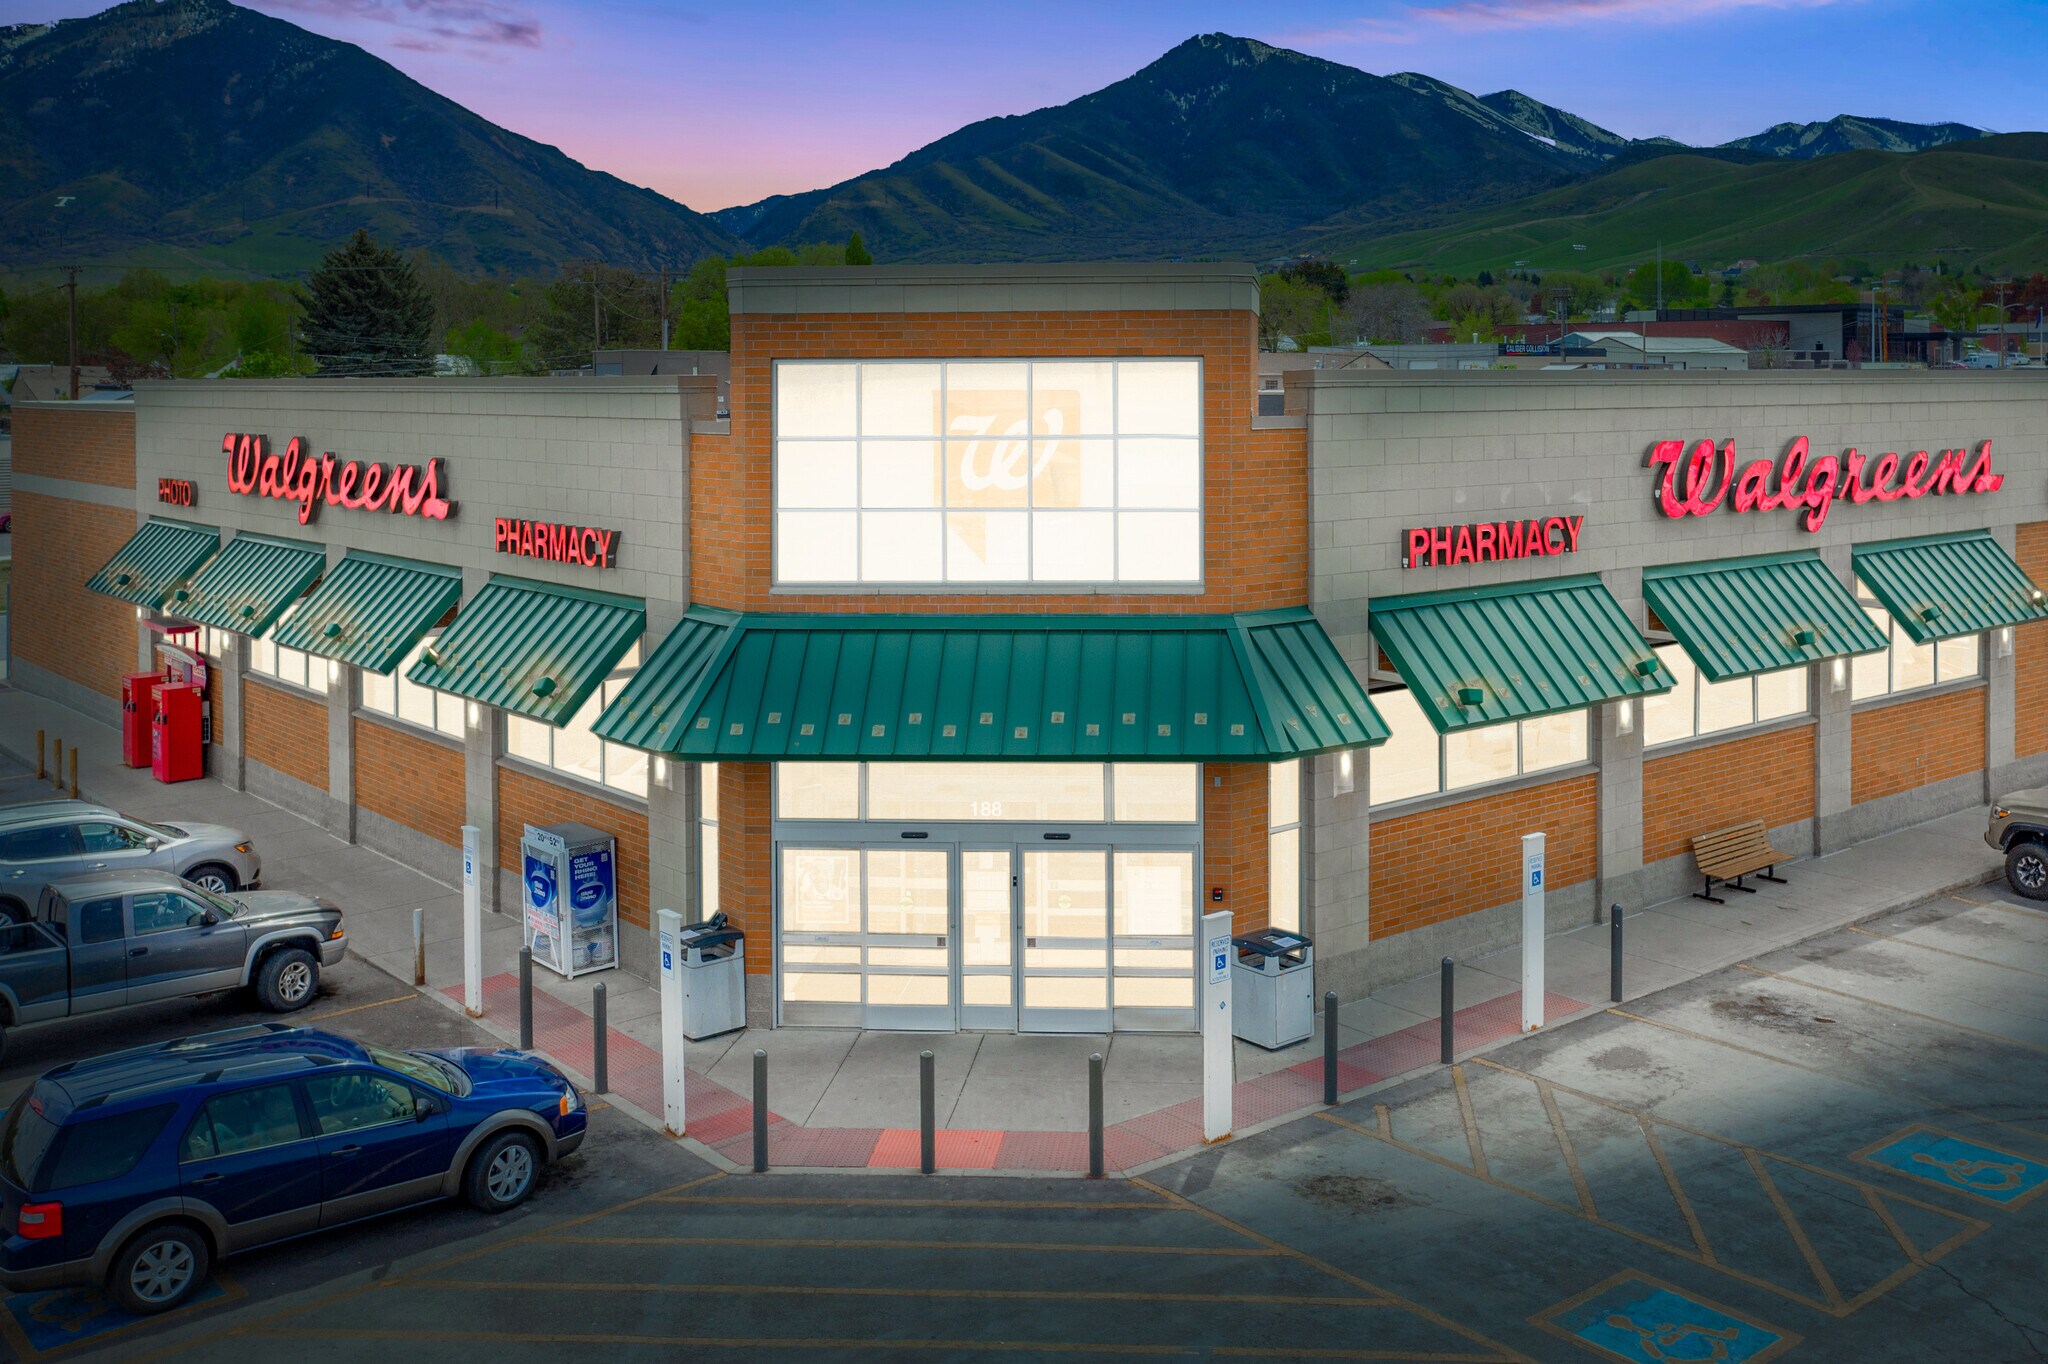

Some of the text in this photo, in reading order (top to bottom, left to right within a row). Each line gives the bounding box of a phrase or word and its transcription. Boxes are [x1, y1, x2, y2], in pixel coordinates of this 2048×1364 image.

[158, 477, 195, 507] PHOTO
[222, 432, 454, 526] Walgreens
[1645, 435, 2005, 534] Walgreens
[495, 517, 616, 569] PHARMACY
[1404, 515, 1584, 569] PHARMACY
[970, 800, 1002, 817] 188
[574, 856, 589, 864] GET
[574, 861, 594, 869] YOUR
[1211, 937, 1230, 947] RESERVED
